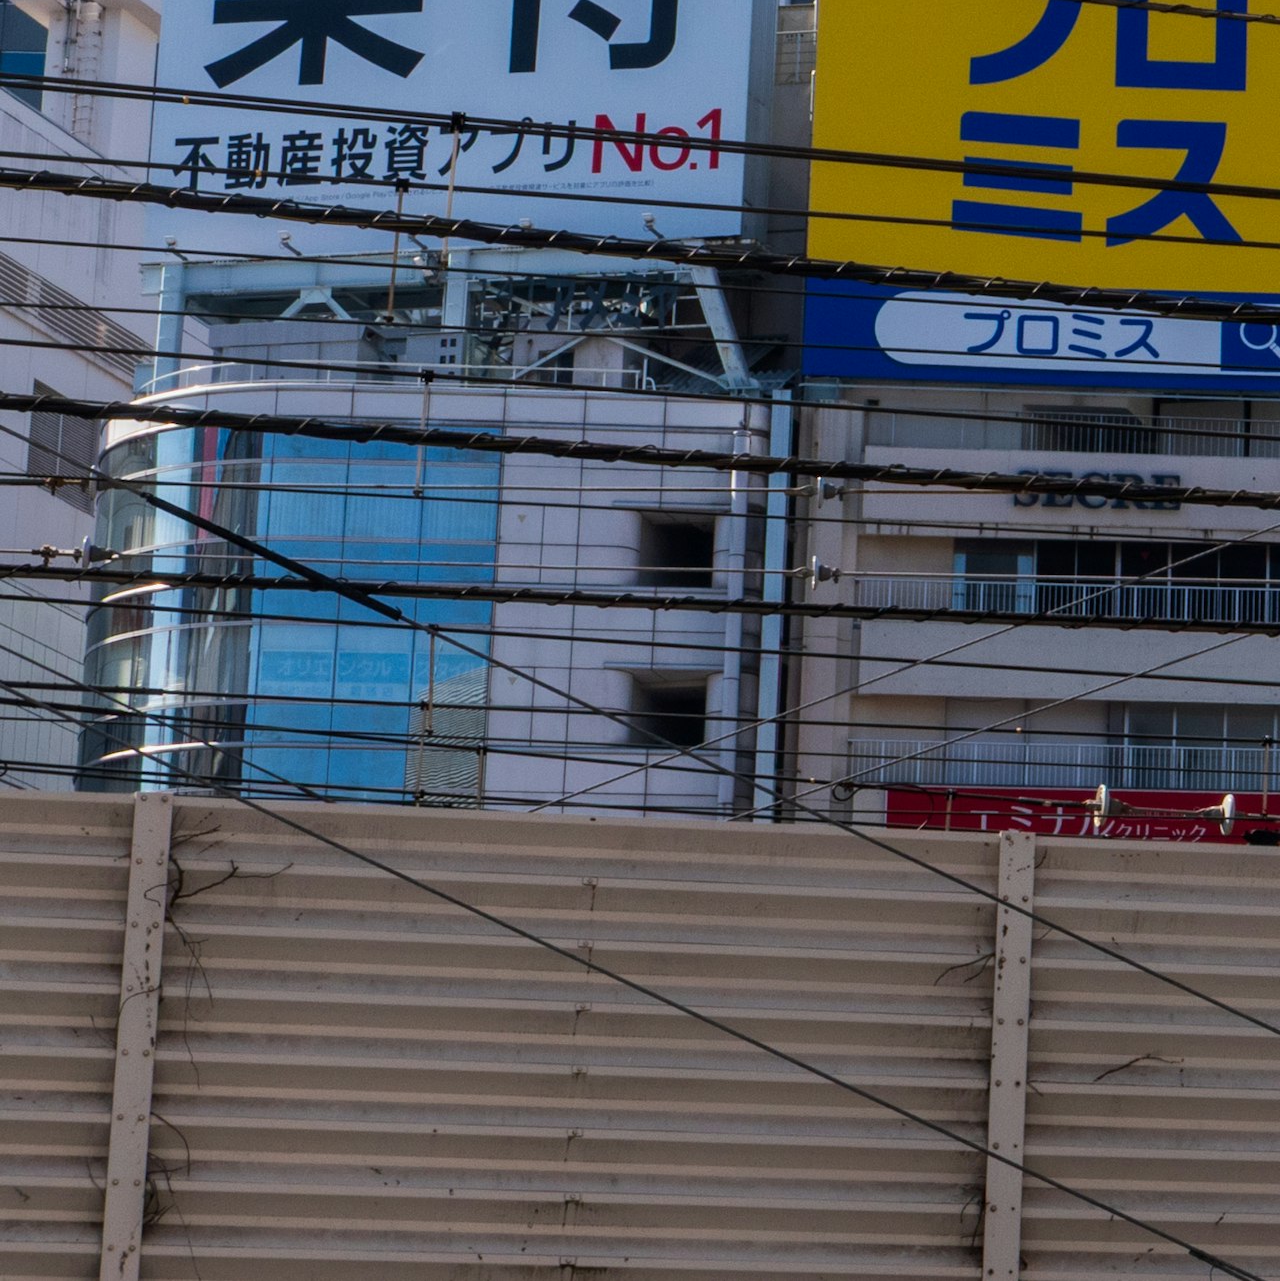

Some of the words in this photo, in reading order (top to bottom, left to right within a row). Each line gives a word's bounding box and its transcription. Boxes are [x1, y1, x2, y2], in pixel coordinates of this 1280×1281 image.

[951, 110, 1243, 247] ミス
[962, 308, 1160, 360] プロミス
